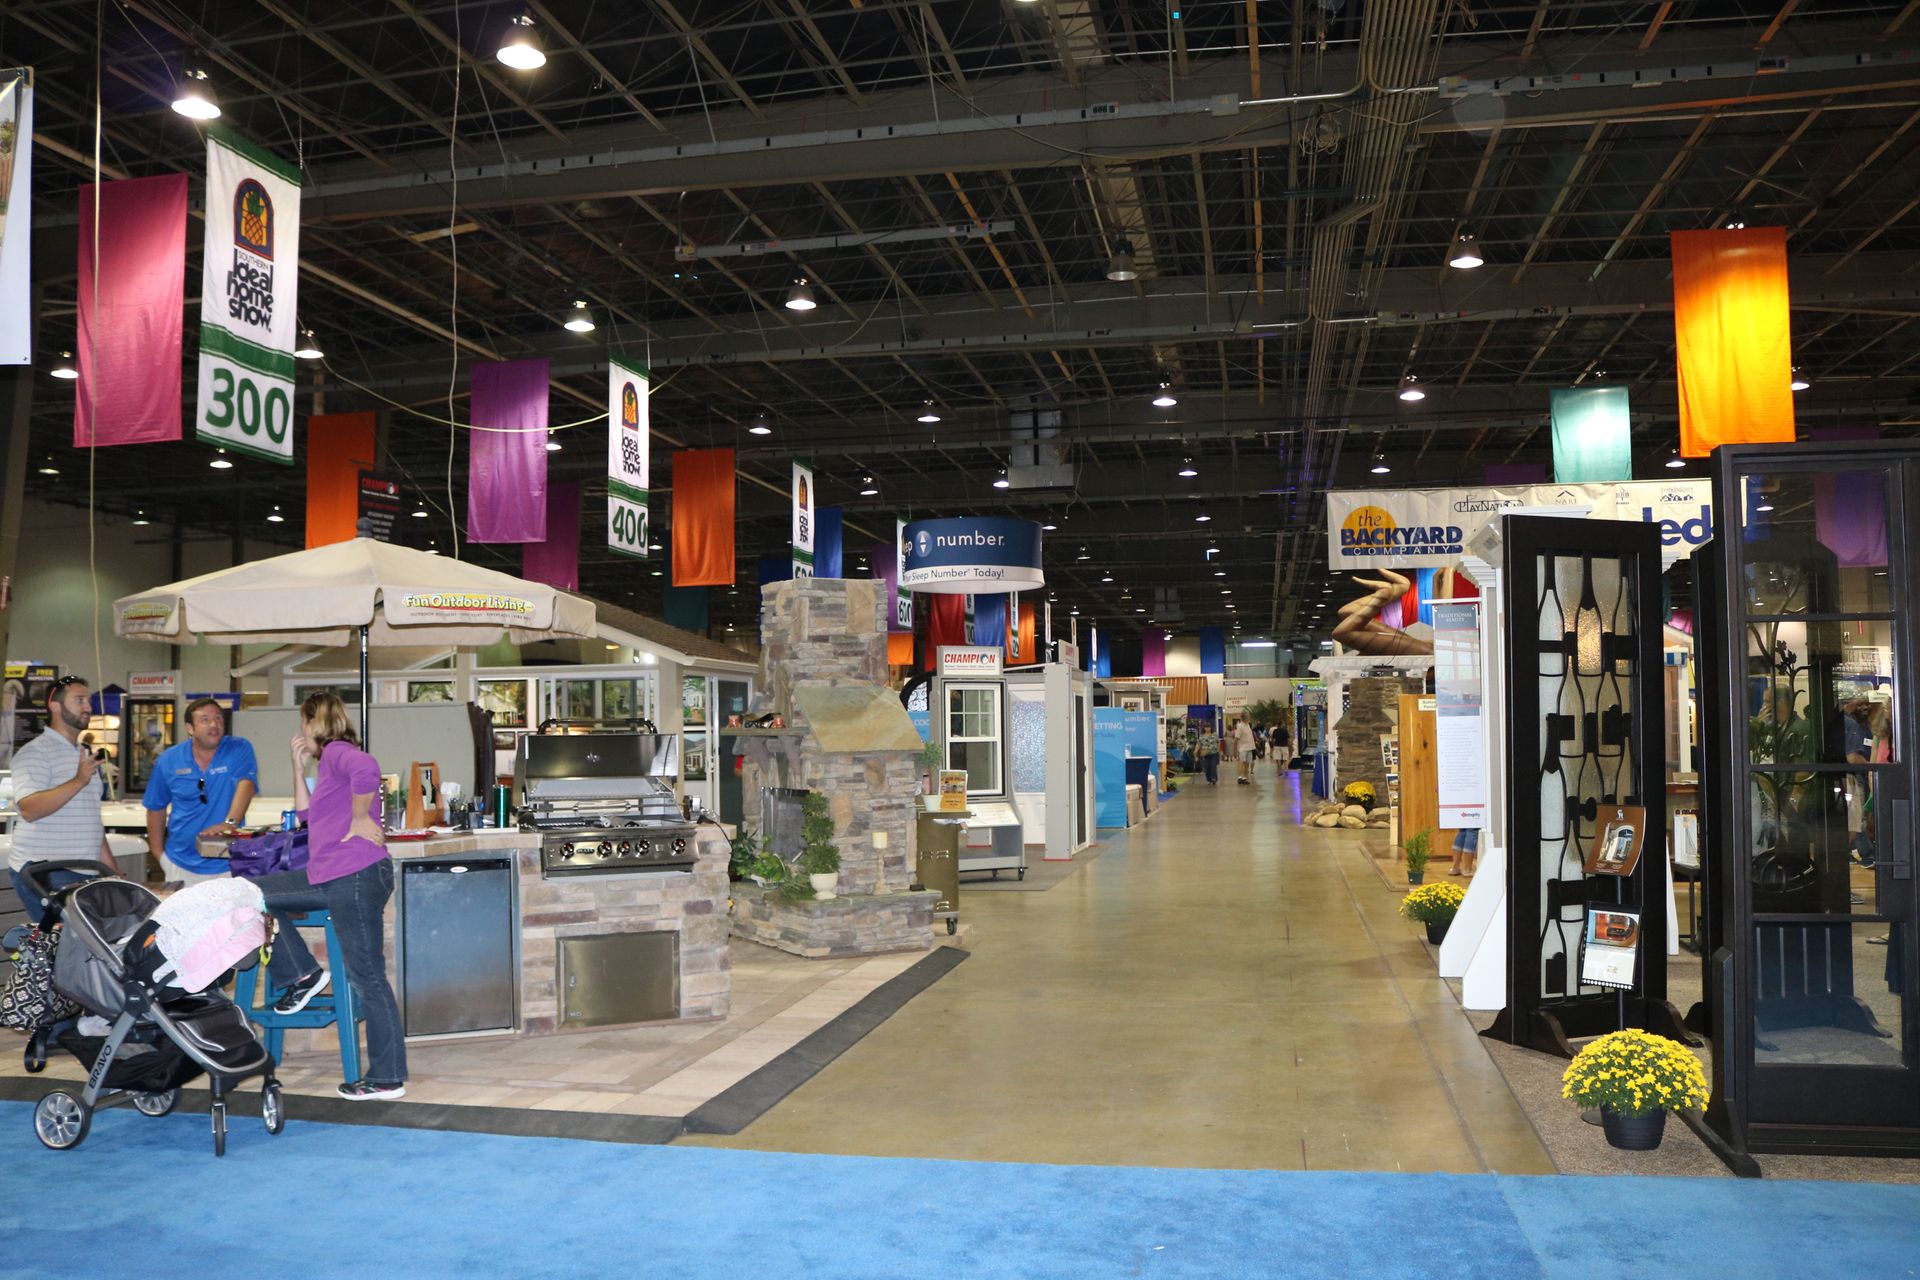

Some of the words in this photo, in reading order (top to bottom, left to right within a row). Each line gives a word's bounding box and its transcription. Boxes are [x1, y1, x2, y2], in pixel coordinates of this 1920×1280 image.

[239, 251, 269, 270] SOUTHERN
[227, 270, 274, 313] home
[205, 367, 290, 444] 300
[612, 505, 648, 548] 400
[1358, 509, 1382, 527] the
[936, 530, 1004, 547] number
[1340, 526, 1463, 546] BACKYARD
[973, 567, 1005, 580] Today!
[404, 594, 430, 608] Fun
[431, 594, 487, 610] Outdoor
[487, 594, 526, 613] Living
[944, 653, 996, 664] CHAMPION
[89, 1045, 112, 1089] BRAVO
